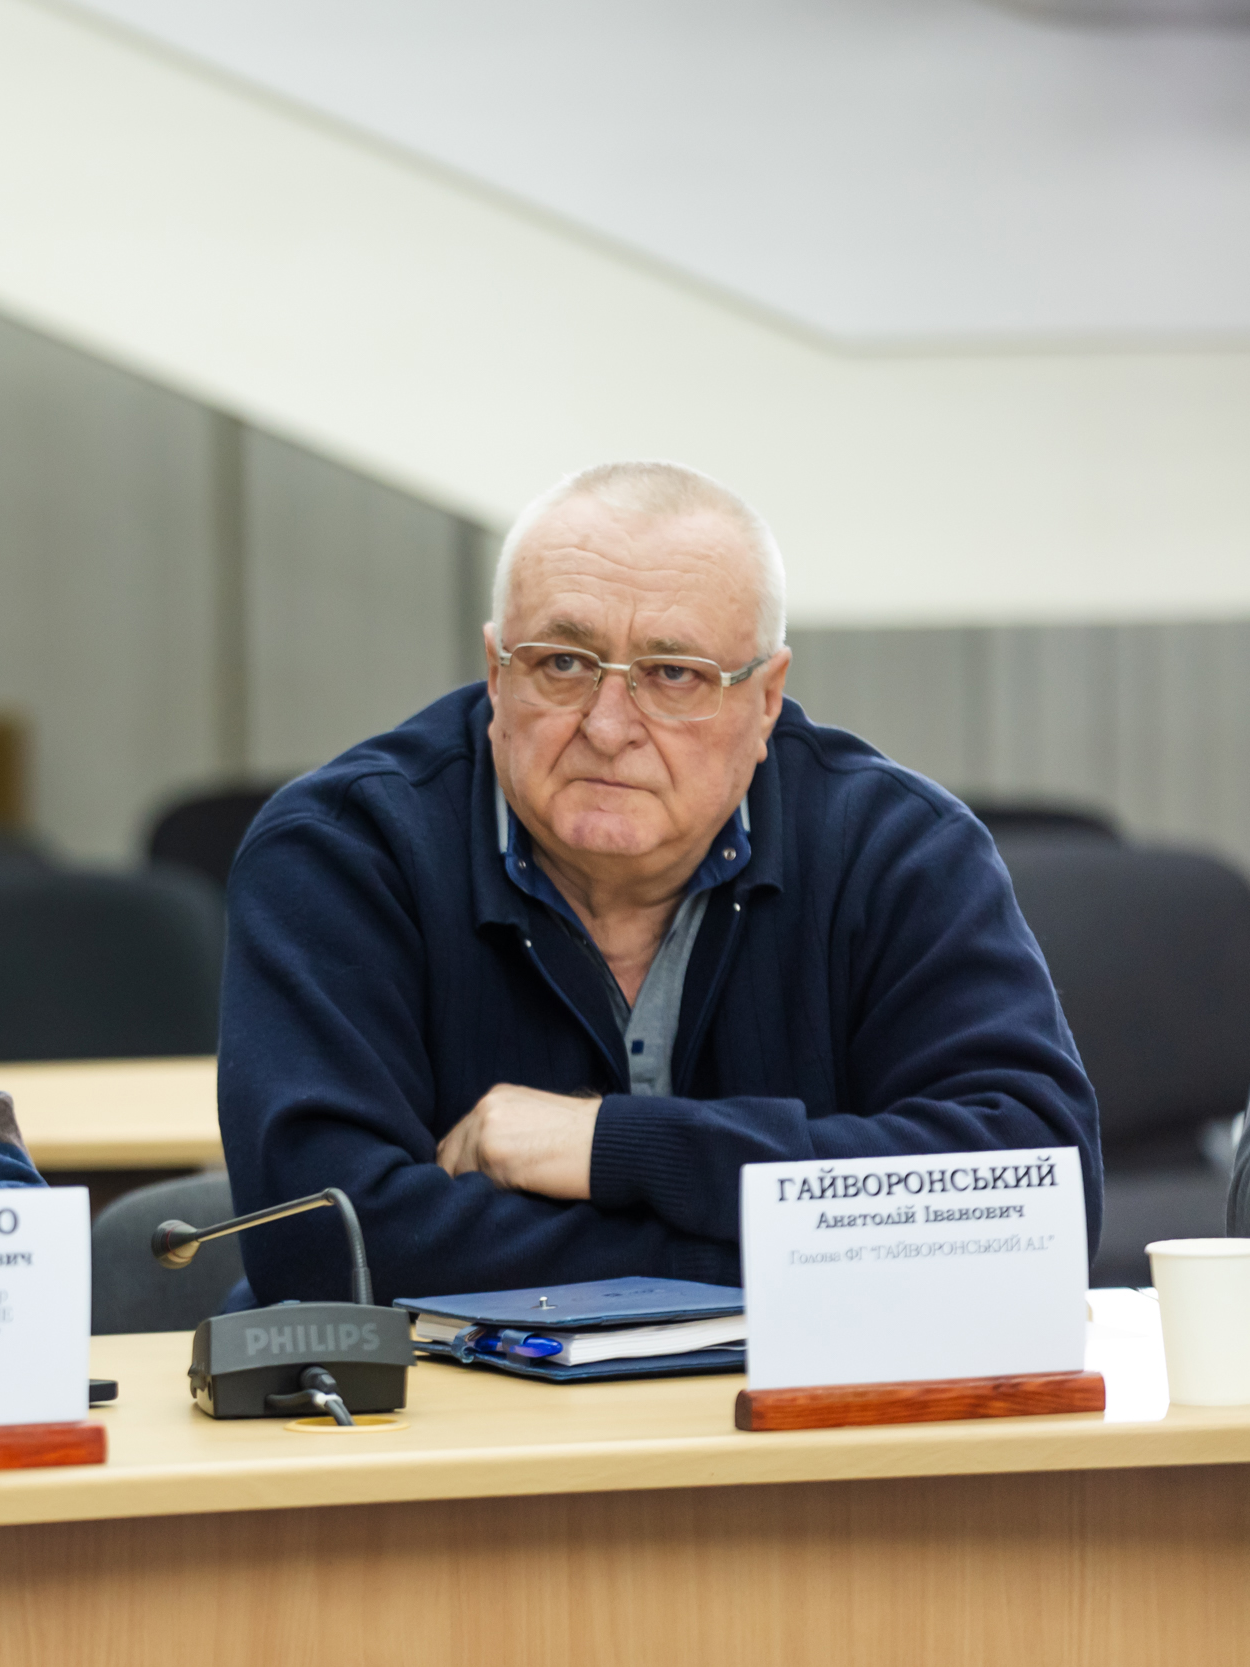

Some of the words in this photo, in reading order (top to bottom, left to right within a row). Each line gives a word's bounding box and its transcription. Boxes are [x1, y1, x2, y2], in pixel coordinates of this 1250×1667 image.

[777, 1154, 1059, 1202] ГАЙВОРОНСЬКИЙ
[816, 1205, 917, 1230] Анатолій
[924, 1204, 1026, 1223] Іванович
[245, 1322, 381, 1356] PHILIPS
